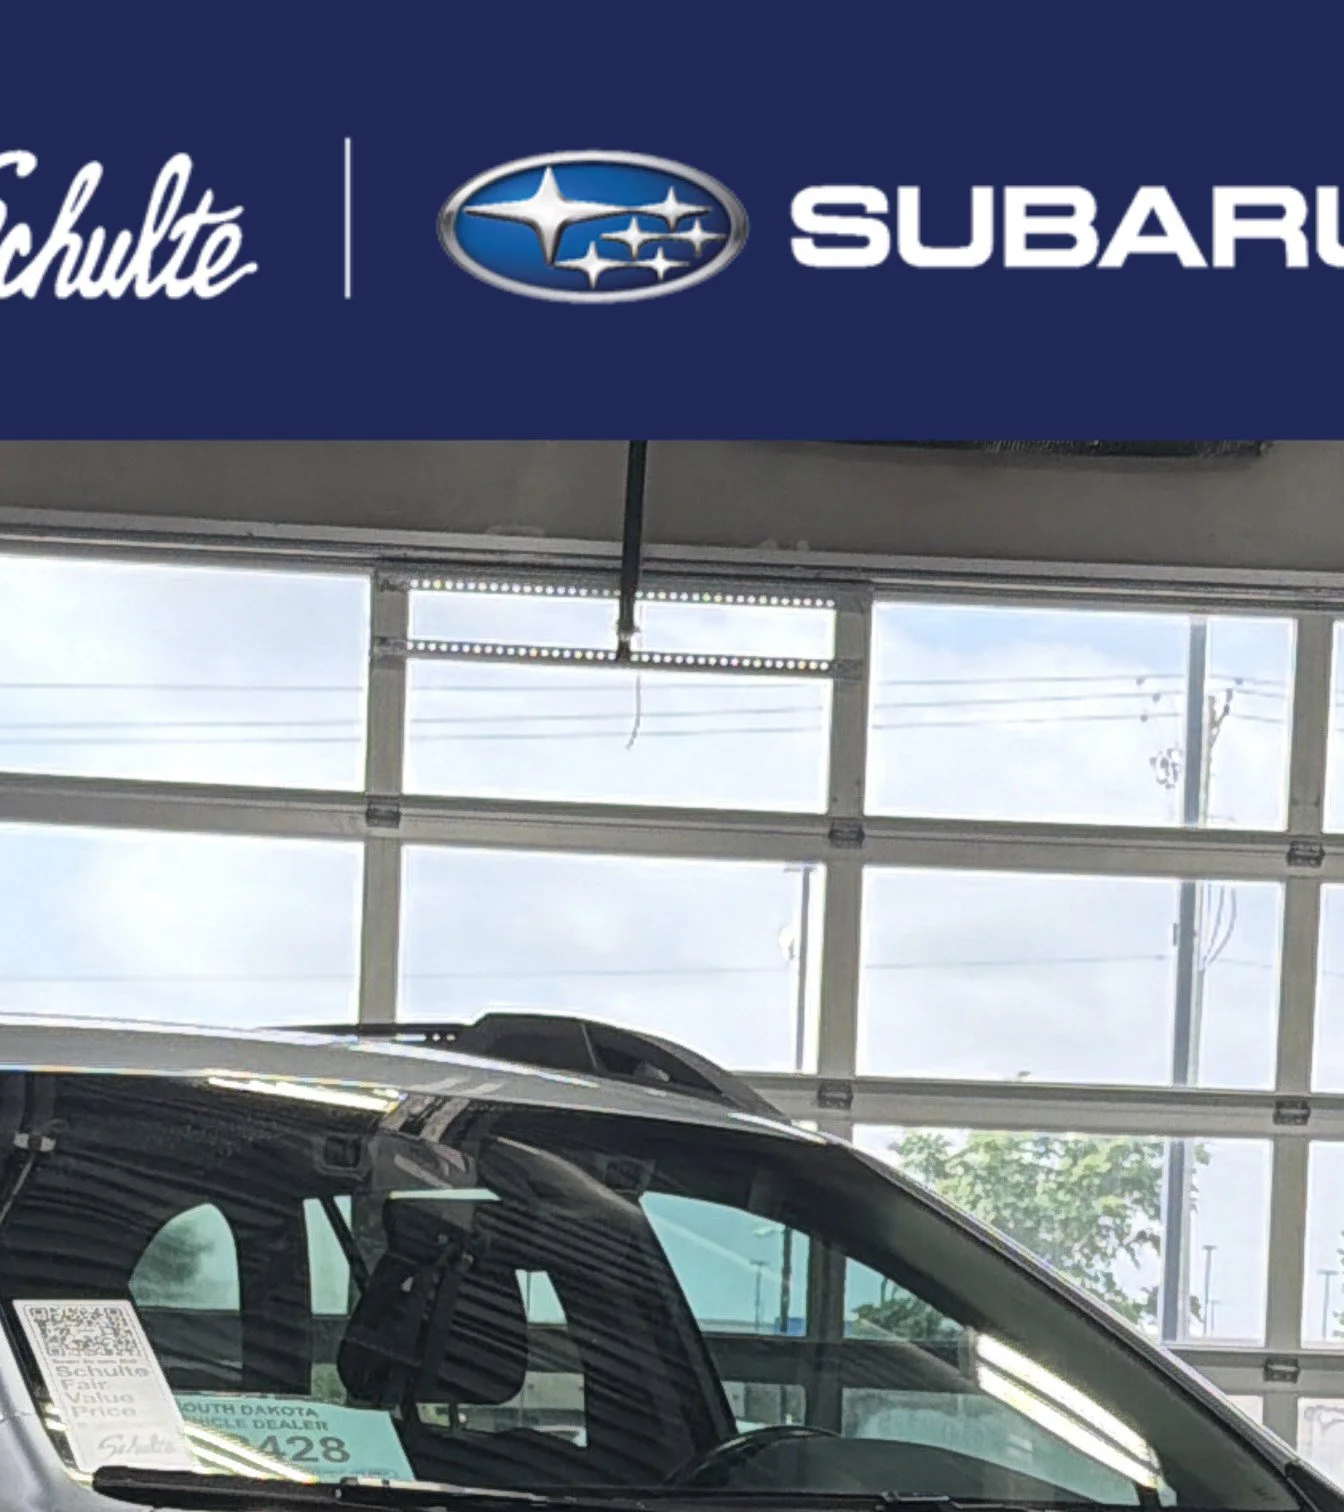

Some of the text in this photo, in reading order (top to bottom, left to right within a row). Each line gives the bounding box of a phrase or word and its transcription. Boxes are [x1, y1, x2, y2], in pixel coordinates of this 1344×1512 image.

[55, 1365, 150, 1378] Schulte
[60, 1379, 107, 1390] Fair
[64, 1391, 135, 1404] Value
[71, 1405, 137, 1418] Price
[241, 1404, 319, 1418] DAKOTA
[253, 1418, 329, 1431] DEALER
[228, 1434, 351, 1463] 428
